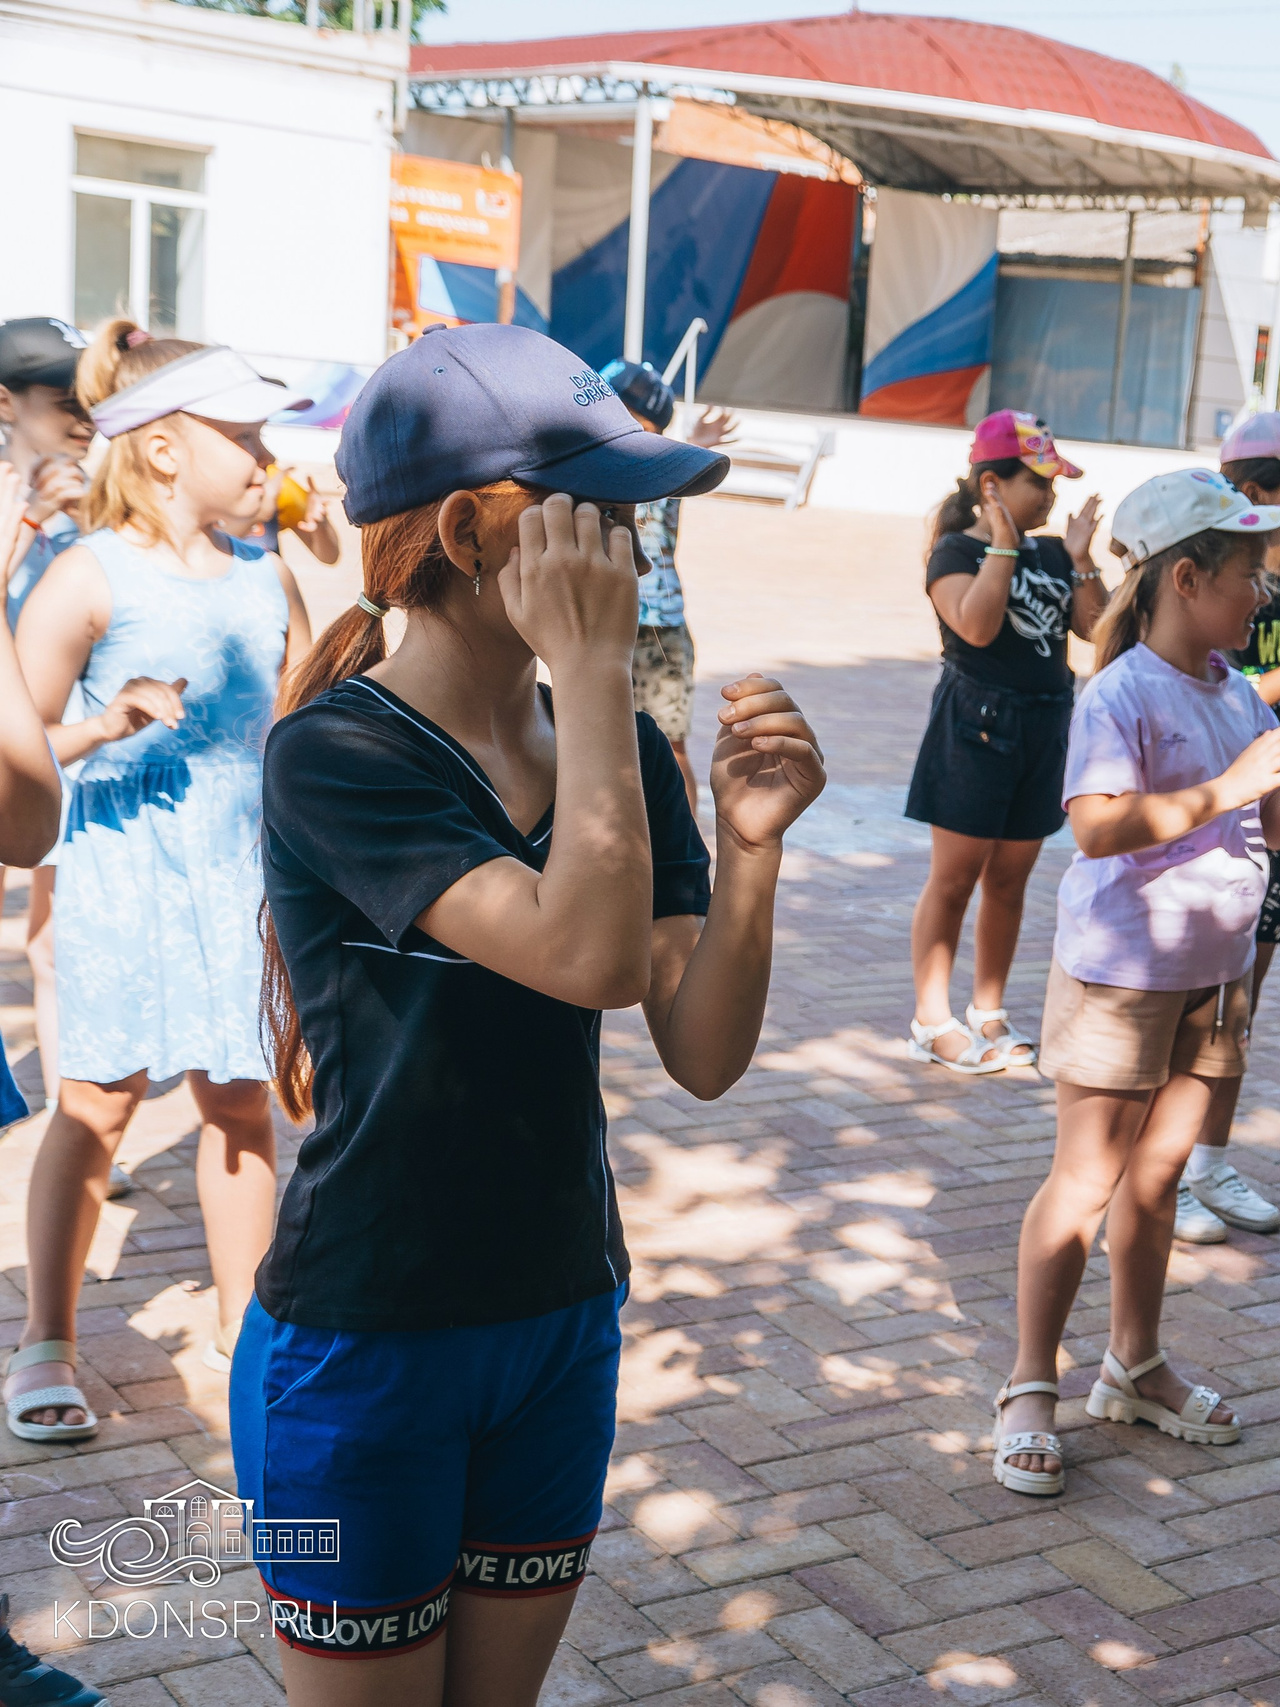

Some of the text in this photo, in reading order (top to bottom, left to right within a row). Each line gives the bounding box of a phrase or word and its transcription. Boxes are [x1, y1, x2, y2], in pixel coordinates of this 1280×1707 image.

[505, 1551, 576, 1584] LOVE
[321, 1615, 400, 1647] LOVE
[407, 1588, 451, 1639] LOVE
